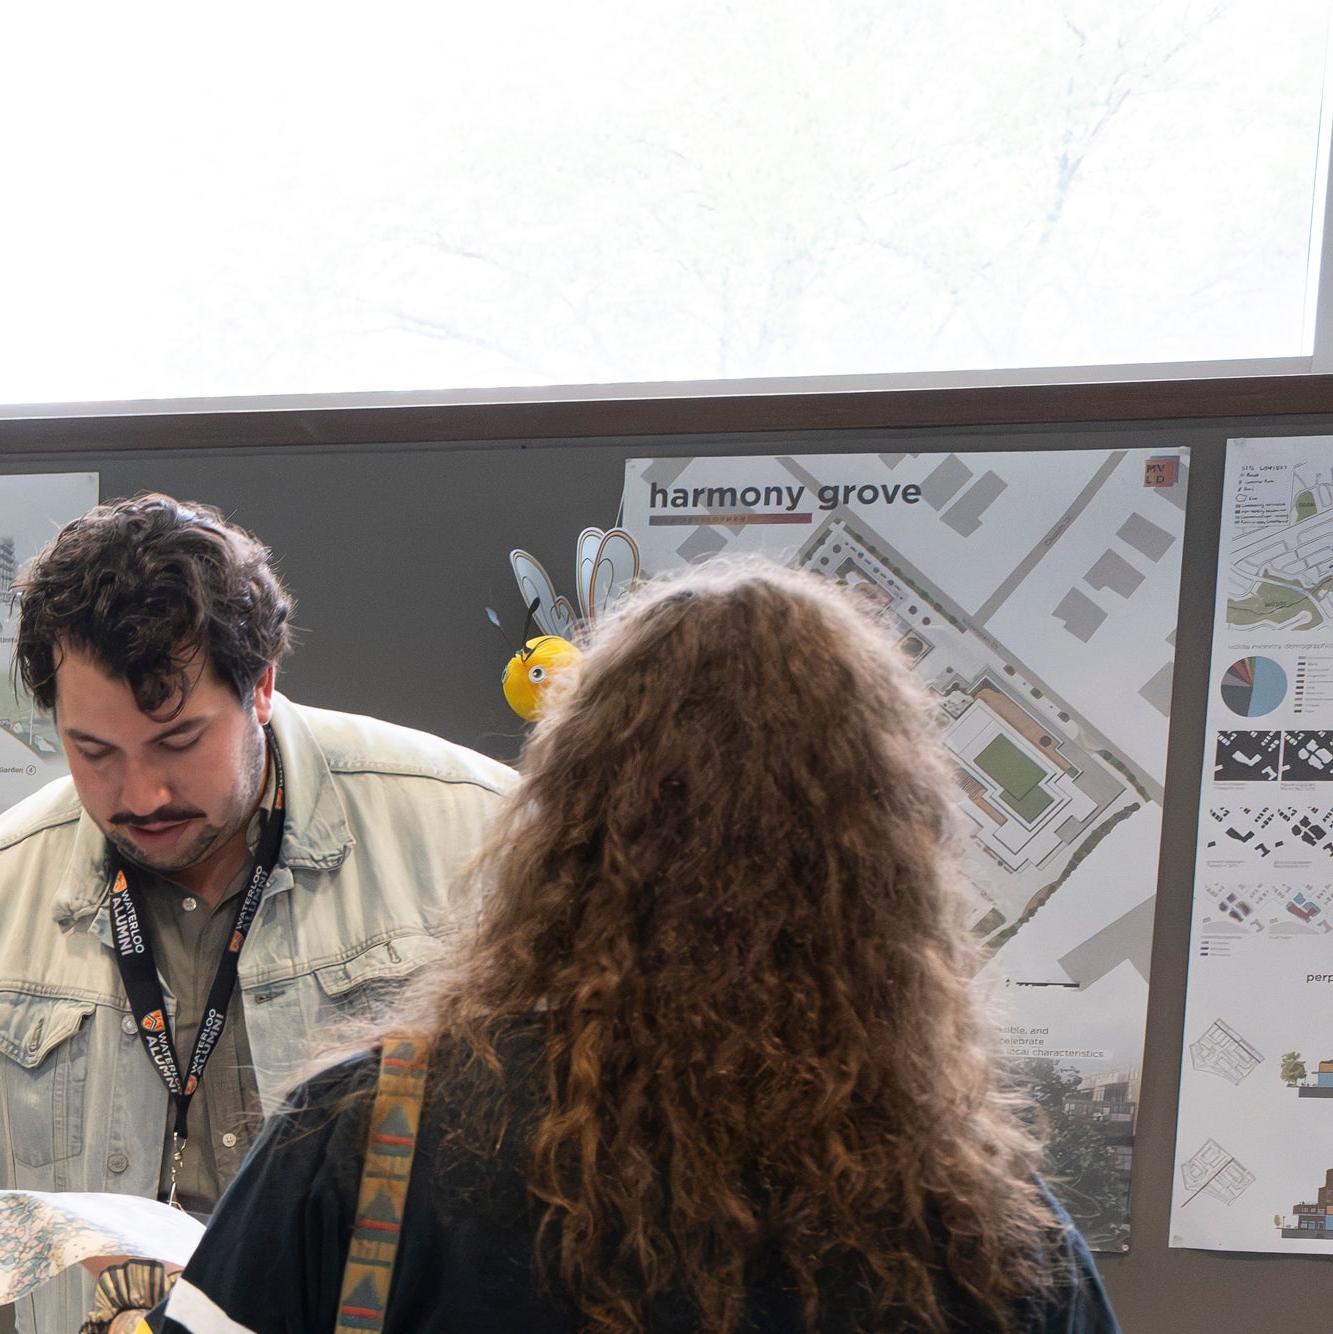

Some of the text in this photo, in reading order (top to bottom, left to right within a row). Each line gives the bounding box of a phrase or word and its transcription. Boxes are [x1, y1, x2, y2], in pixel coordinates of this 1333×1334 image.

[649, 482, 922, 511] harmony grove
[111, 897, 133, 956] ALUMNI
[122, 890, 145, 954] WATERLOO
[235, 865, 263, 930] WATERLOO
[190, 1008, 217, 1074] WATERLOO
[195, 1013, 225, 1077] ALUMNI
[1000, 1037, 1045, 1046] celebrate
[1030, 1027, 1049, 1035] and
[1033, 1049, 1104, 1058] characteristics
[146, 1035, 178, 1095] ALUMNI
